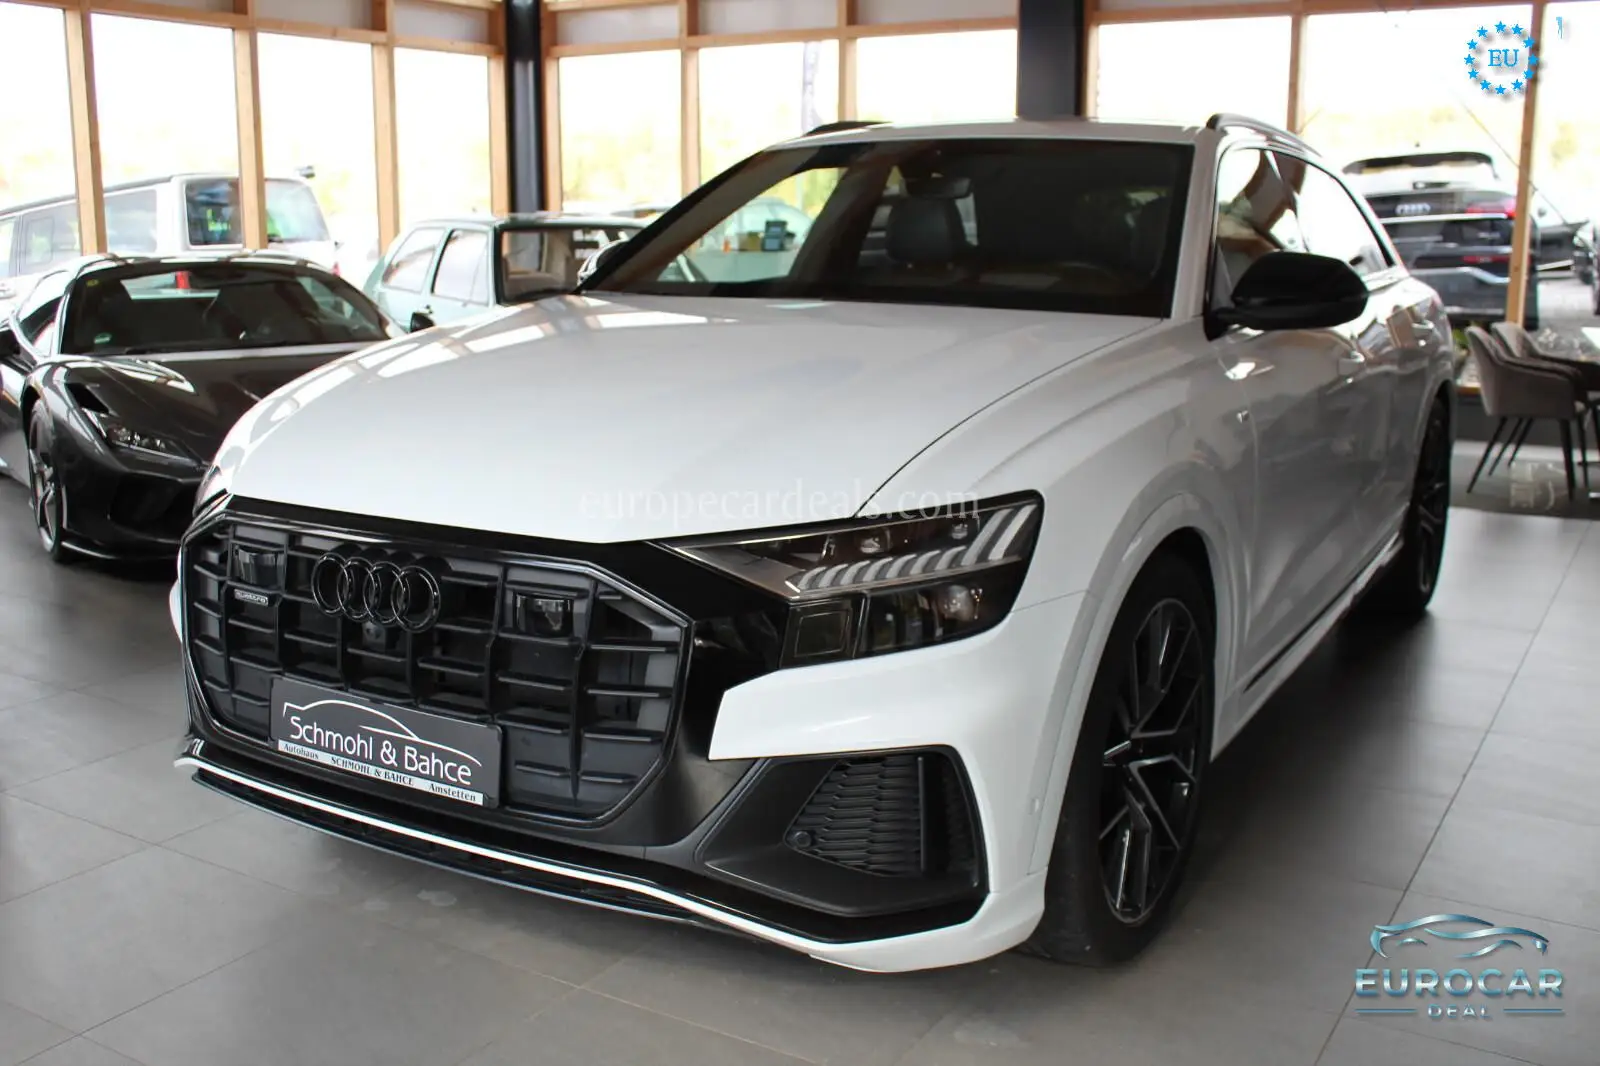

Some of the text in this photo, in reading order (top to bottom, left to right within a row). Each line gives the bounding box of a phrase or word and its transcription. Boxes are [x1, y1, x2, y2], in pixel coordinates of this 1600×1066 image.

[290, 716, 472, 786] Schmohl & Bahce
[331, 756, 371, 775] SCHMOHL
[428, 782, 476, 802] Amstetten
